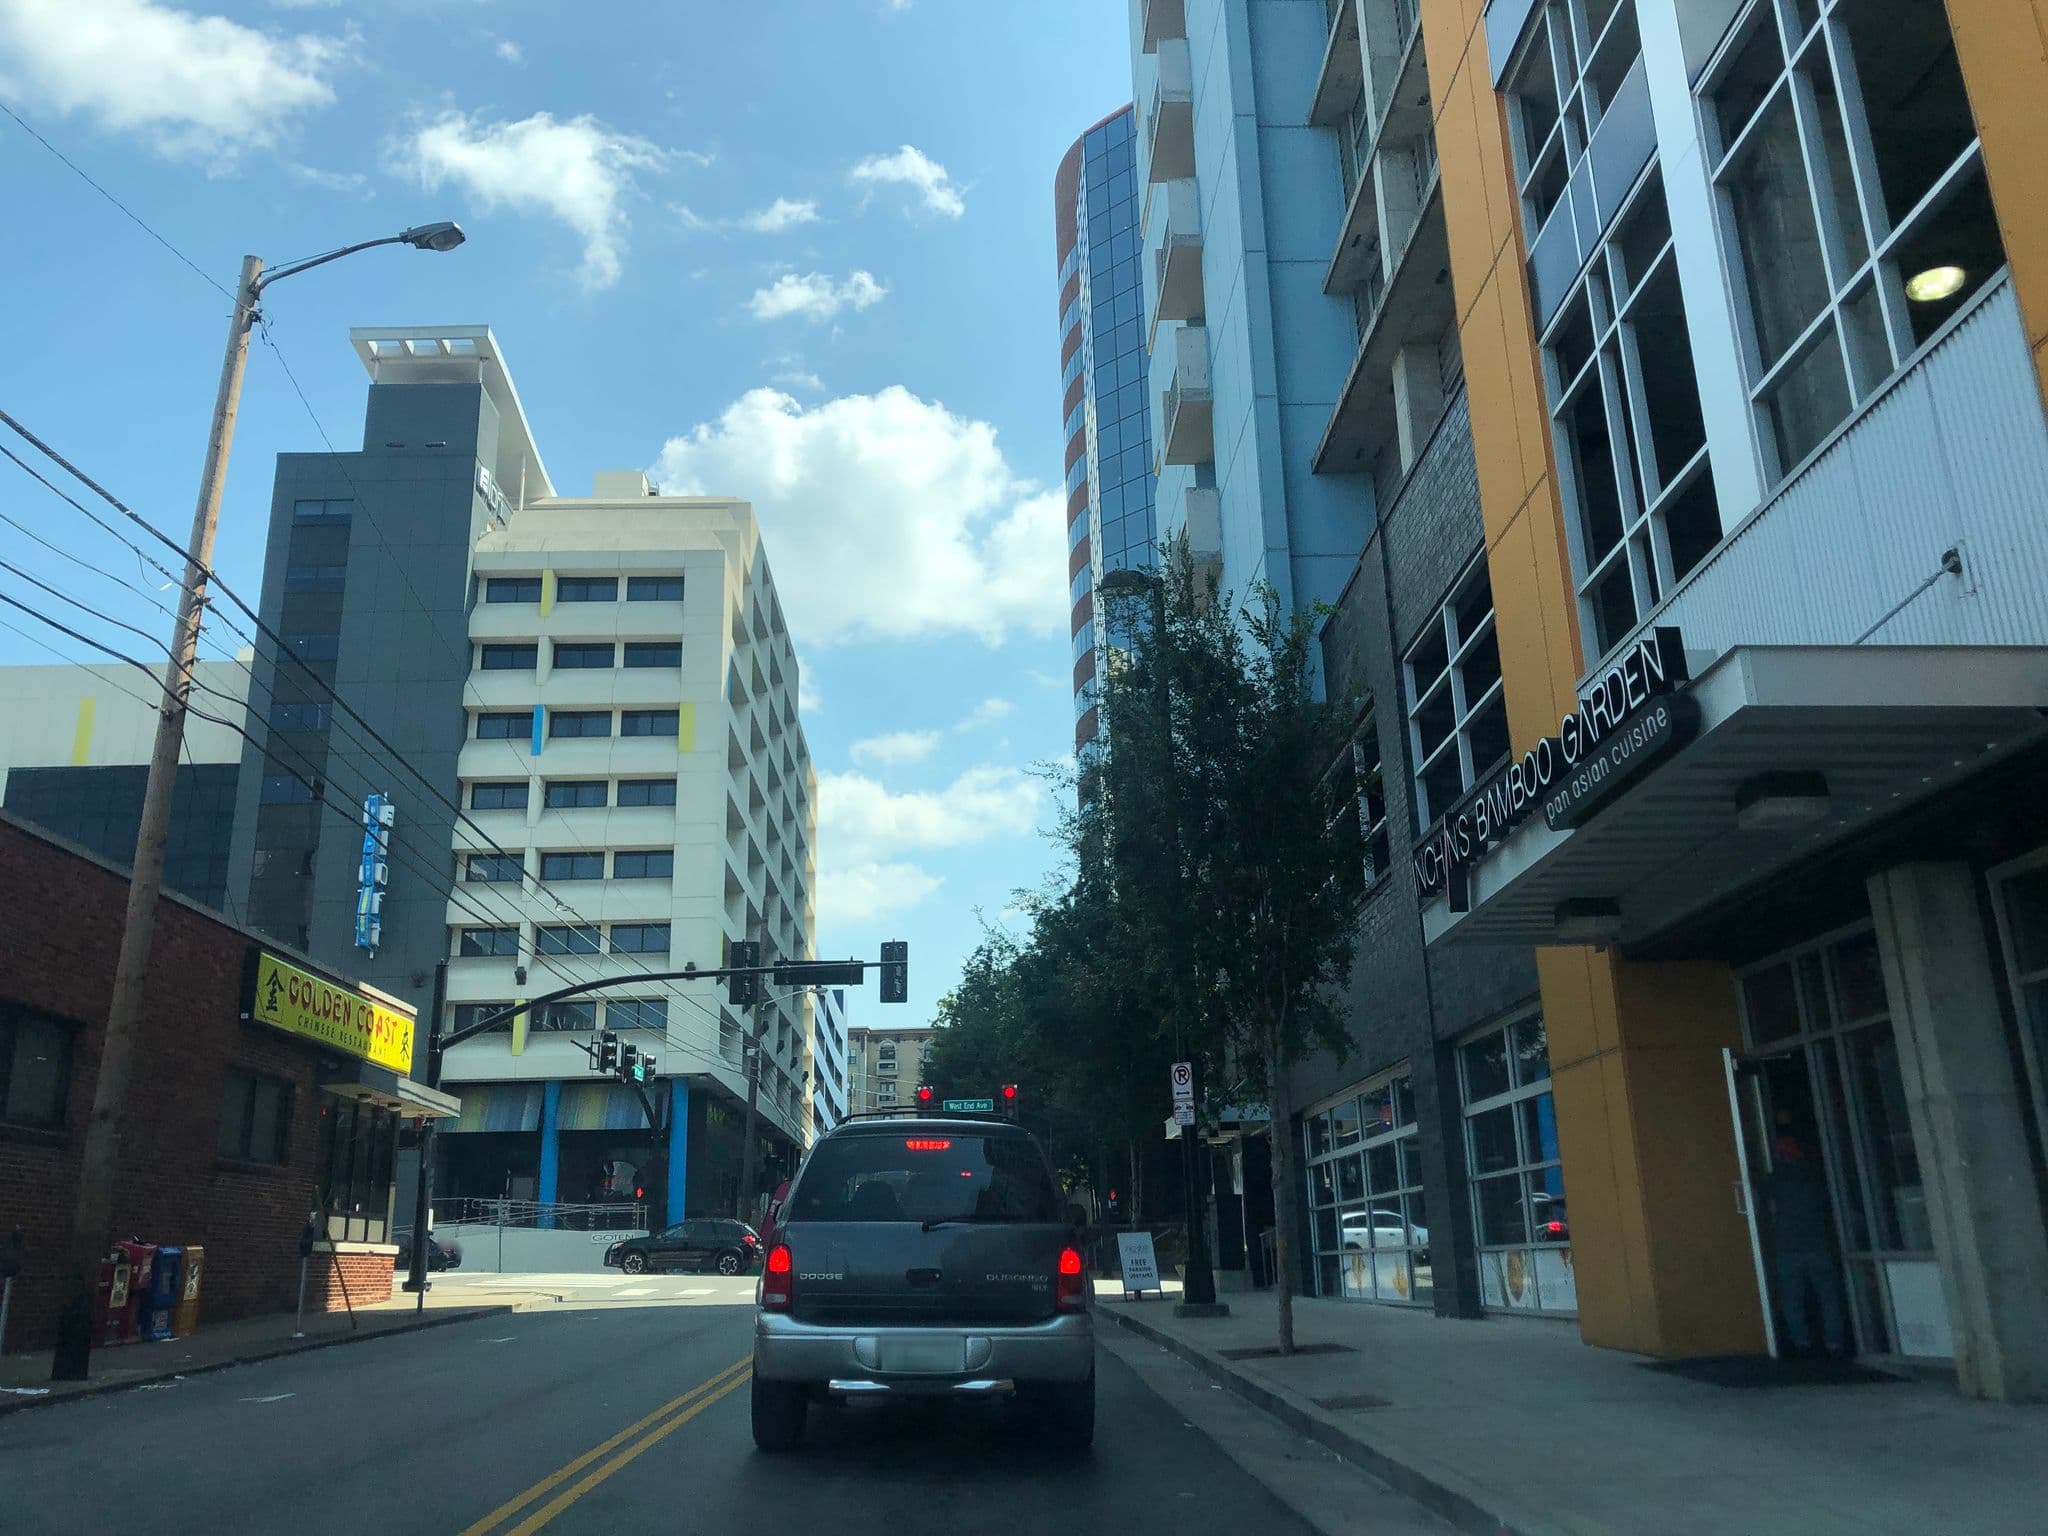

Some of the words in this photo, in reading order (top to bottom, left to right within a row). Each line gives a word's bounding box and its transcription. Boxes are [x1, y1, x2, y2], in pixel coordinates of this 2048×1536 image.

[1475, 737, 1552, 841] BAMBOO
[1560, 627, 1665, 764] GARDEN
[1546, 790, 1571, 826] pan
[1572, 756, 1609, 798] asian
[1611, 706, 1668, 765] cuisine
[288, 975, 352, 1028] GOLDEN
[356, 1003, 398, 1046] COAST
[297, 1014, 335, 1038] CHINESE
[949, 1102, 962, 1110] West
[963, 1102, 975, 1110] End
